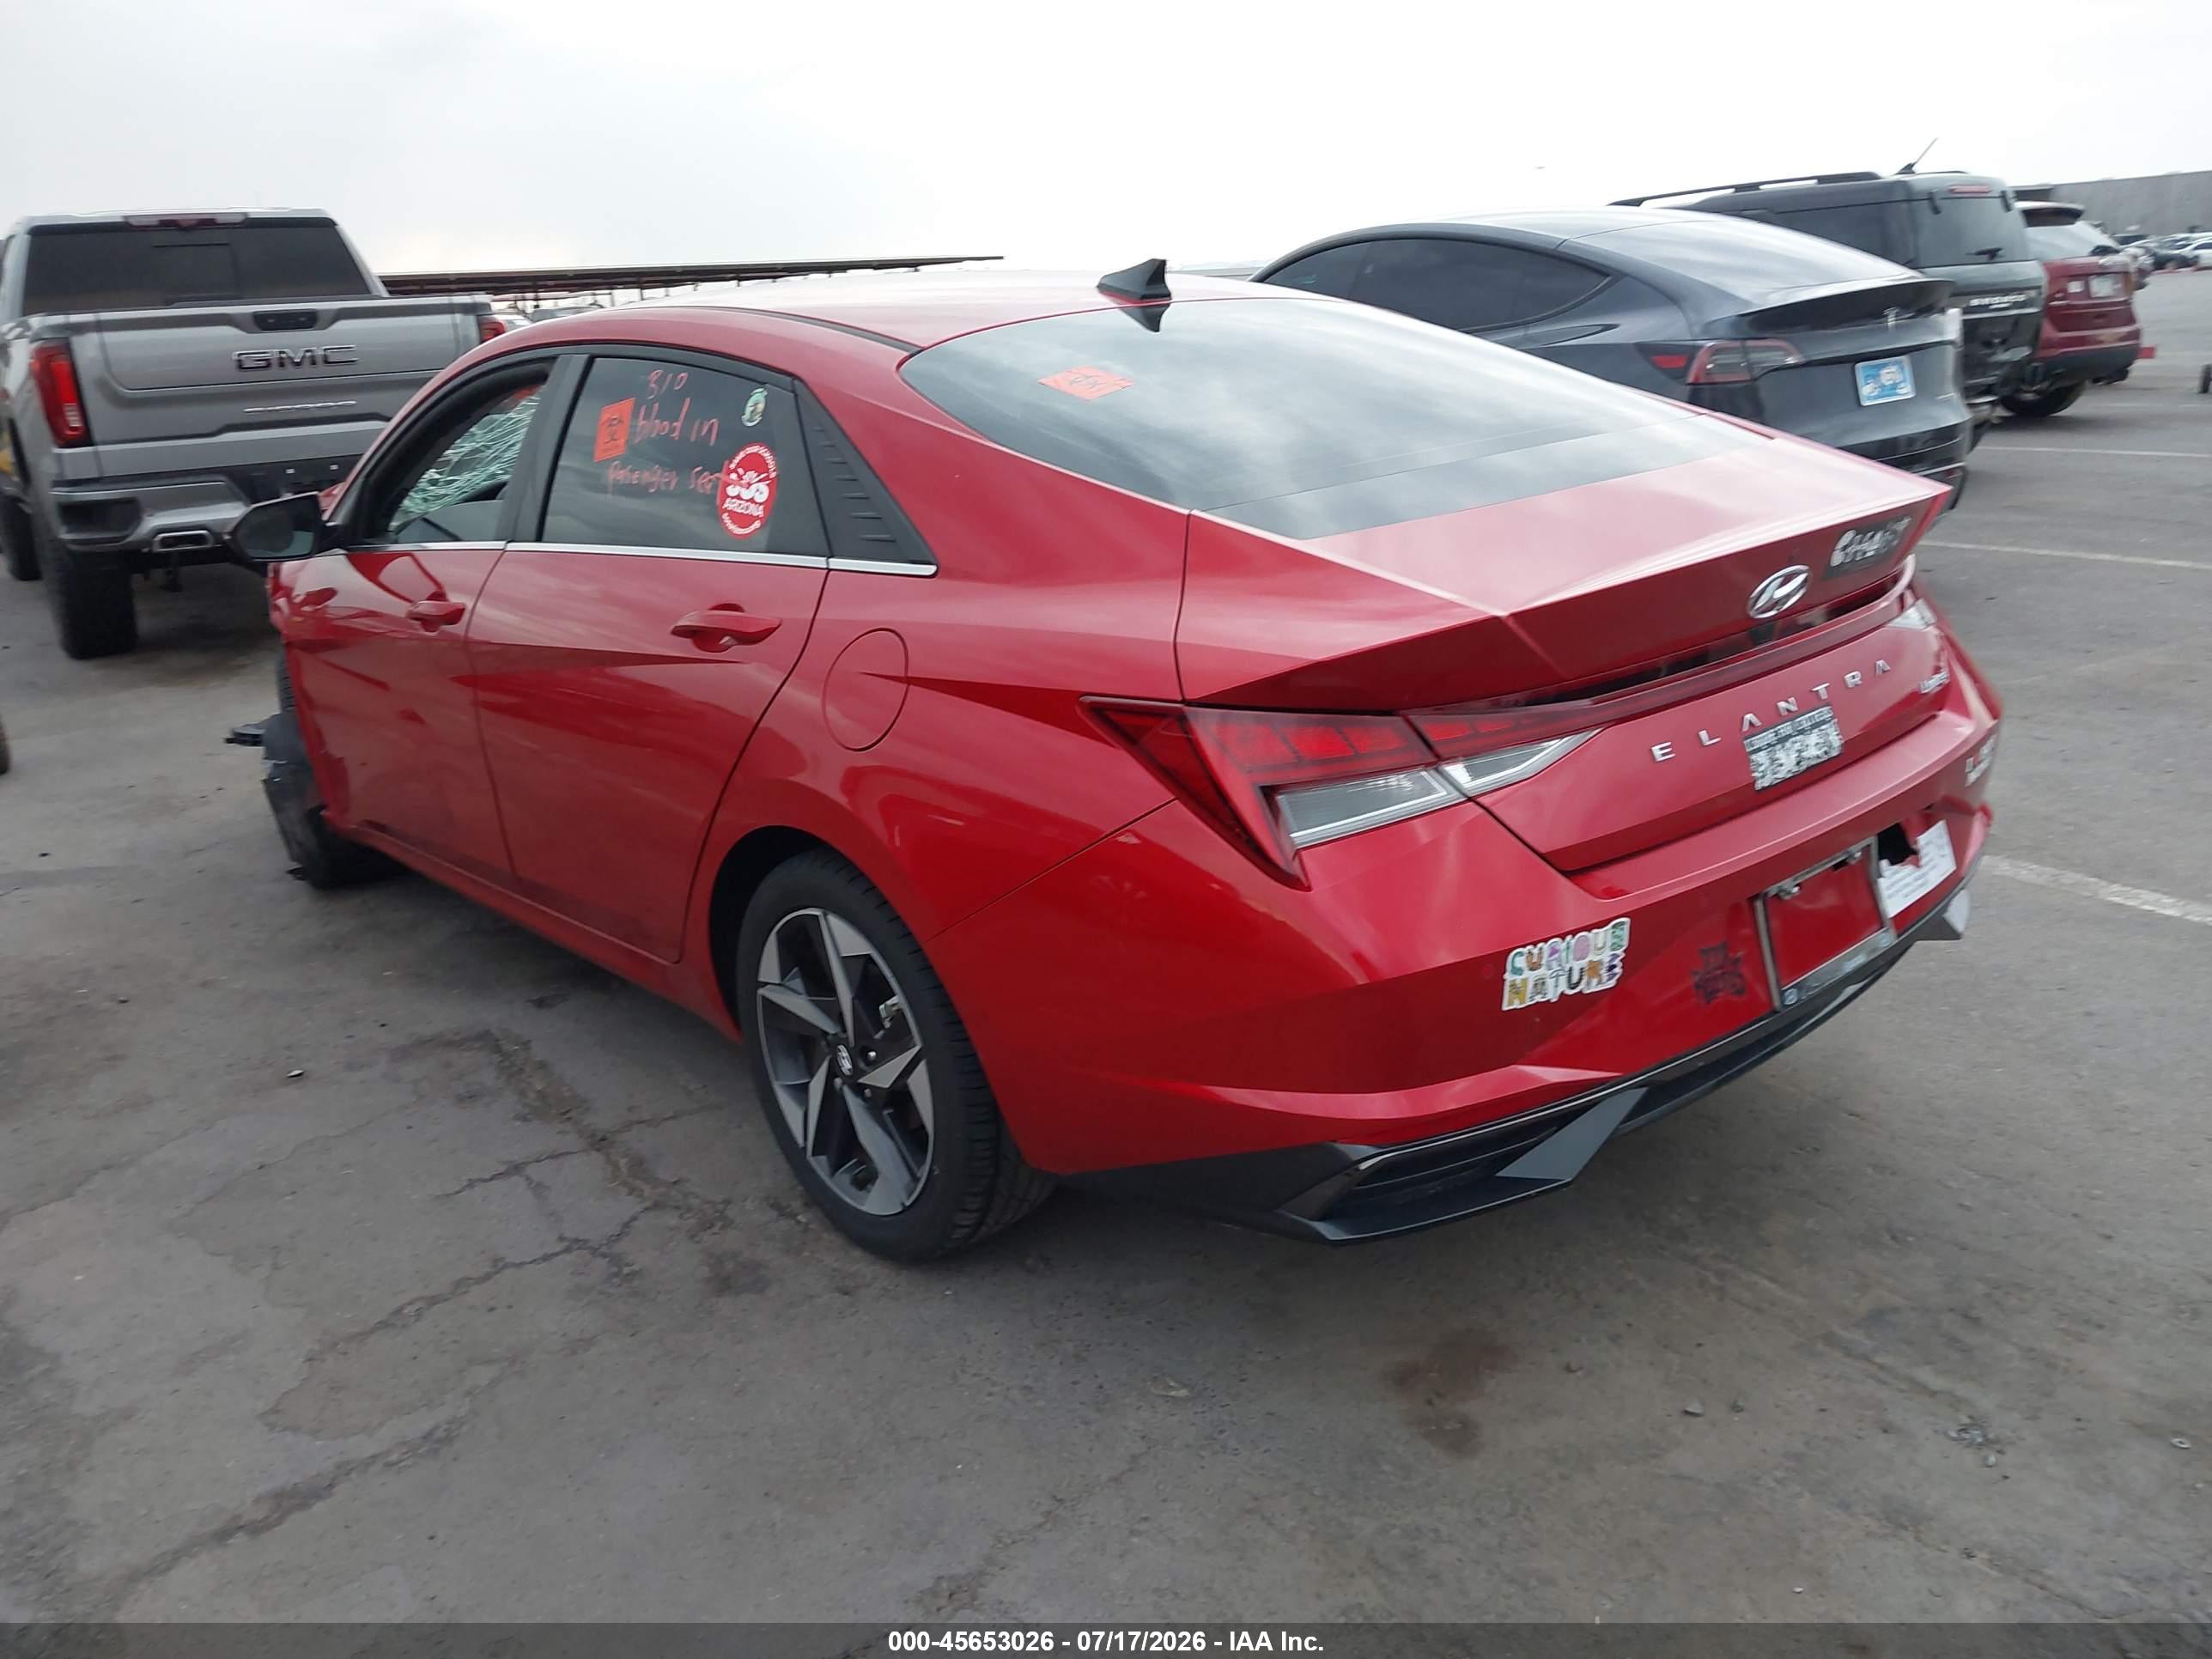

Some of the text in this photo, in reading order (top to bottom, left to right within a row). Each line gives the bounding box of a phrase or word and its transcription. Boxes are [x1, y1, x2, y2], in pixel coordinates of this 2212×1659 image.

[233, 344, 359, 372] GMC
[1650, 659, 1892, 763] ELANTRA
[1508, 921, 1626, 976] CURIOUS
[1505, 952, 1621, 1007] NATURE
